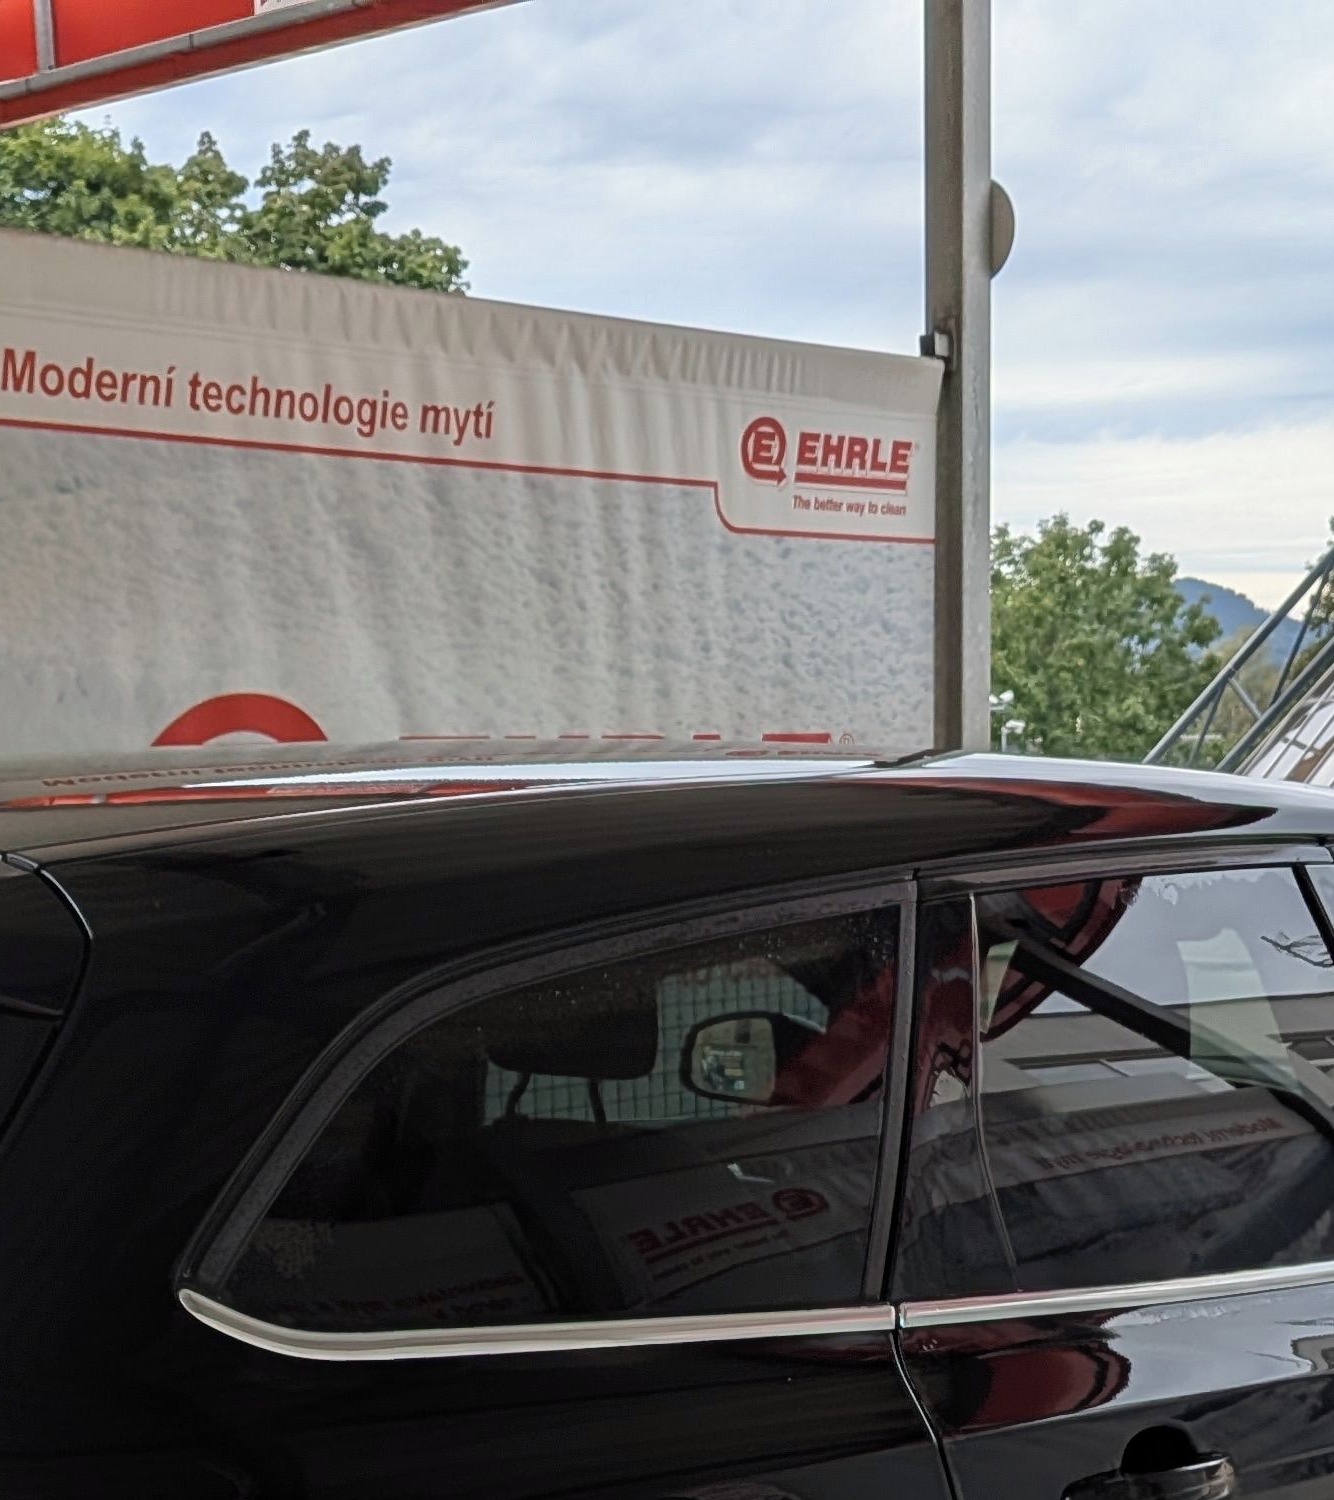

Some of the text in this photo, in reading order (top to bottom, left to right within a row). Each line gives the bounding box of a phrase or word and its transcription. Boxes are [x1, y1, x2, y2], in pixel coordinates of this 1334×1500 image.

[0, 347, 496, 446] Moderní technologie mytí
[796, 431, 913, 474] EHRLE
[792, 494, 907, 517] The better way to clean
